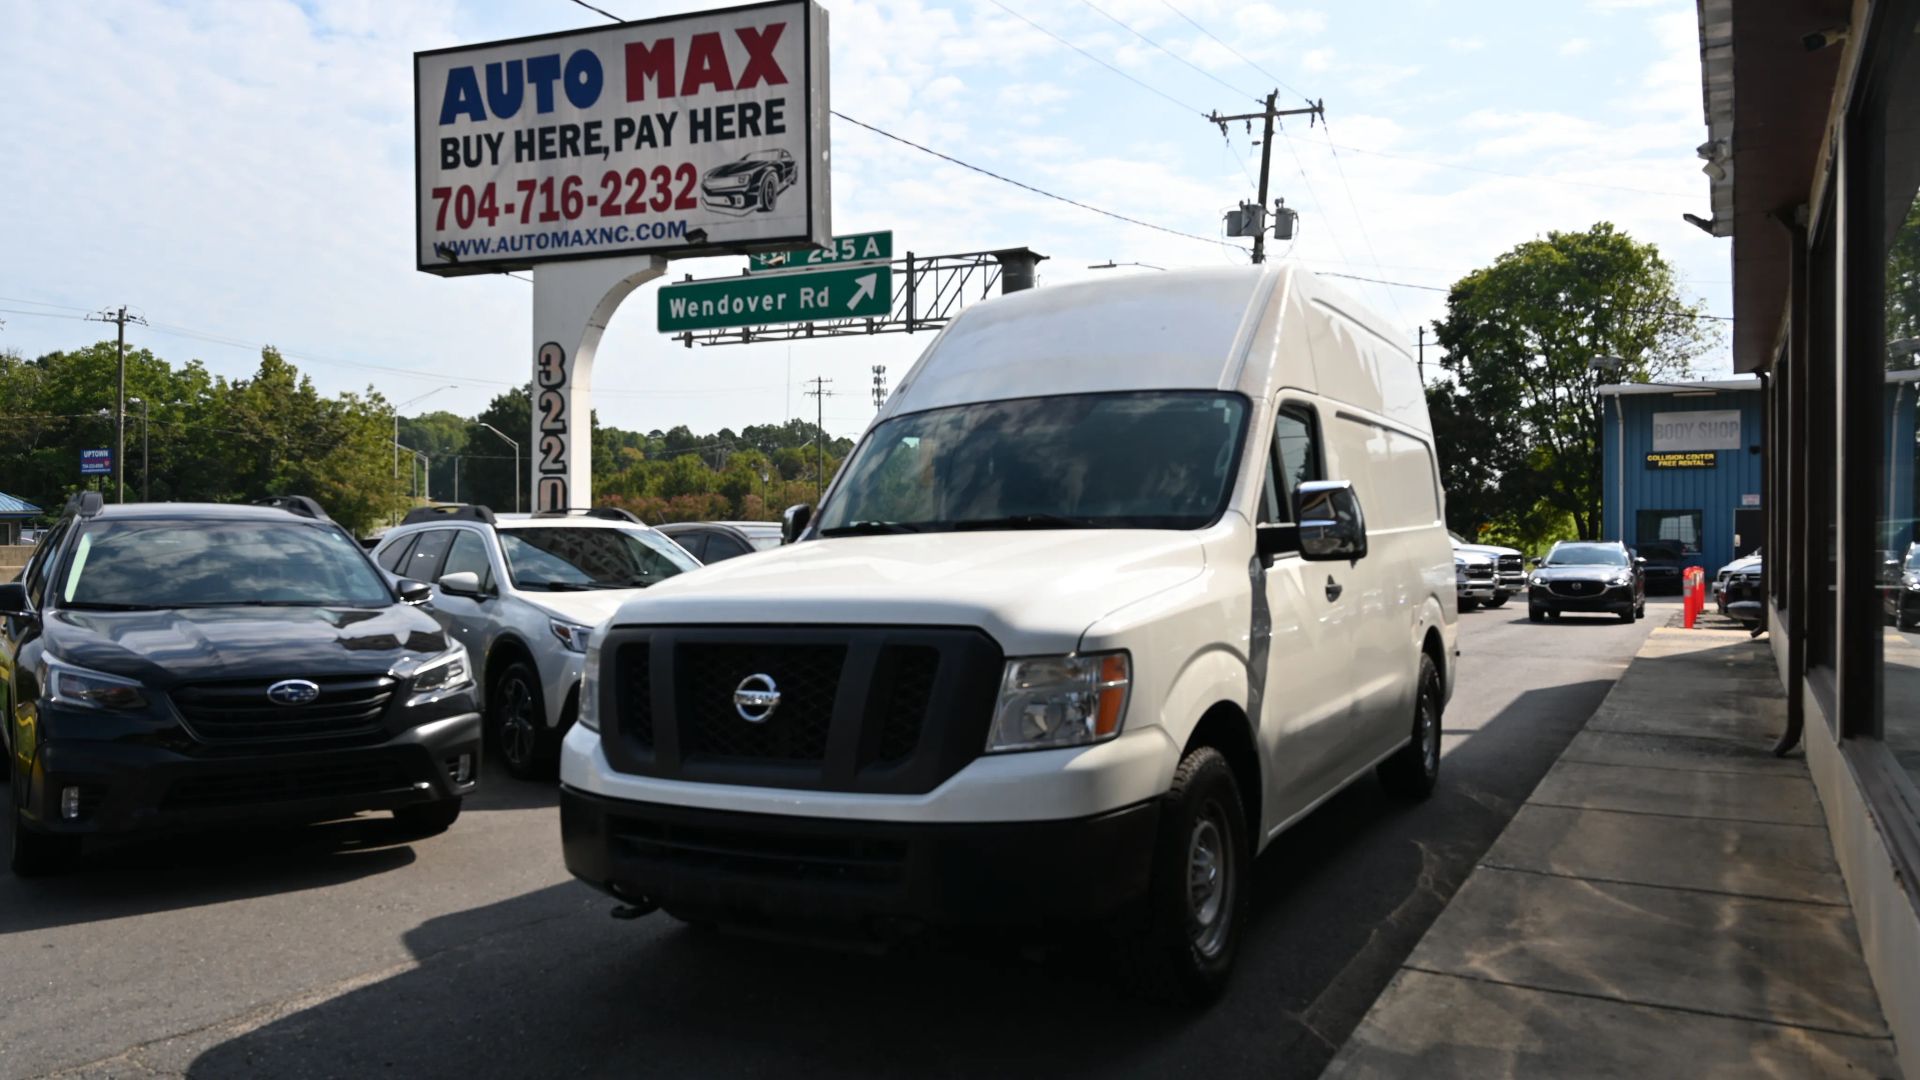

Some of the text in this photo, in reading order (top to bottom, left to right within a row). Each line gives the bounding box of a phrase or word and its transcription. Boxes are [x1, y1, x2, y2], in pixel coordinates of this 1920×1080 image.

[439, 22, 788, 125] AUTO MAX
[440, 132, 505, 170] BUY
[614, 111, 678, 152] PAY
[690, 98, 786, 144] HERE
[432, 162, 698, 231] 704-716-2232
[433, 220, 687, 258] WWW.AUTOMAXNC.COM
[862, 236, 881, 258] A
[669, 286, 829, 319] Wendover Rd
[1655, 421, 1739, 440] BODY SHOP
[83, 450, 109, 458] UPTOWN
